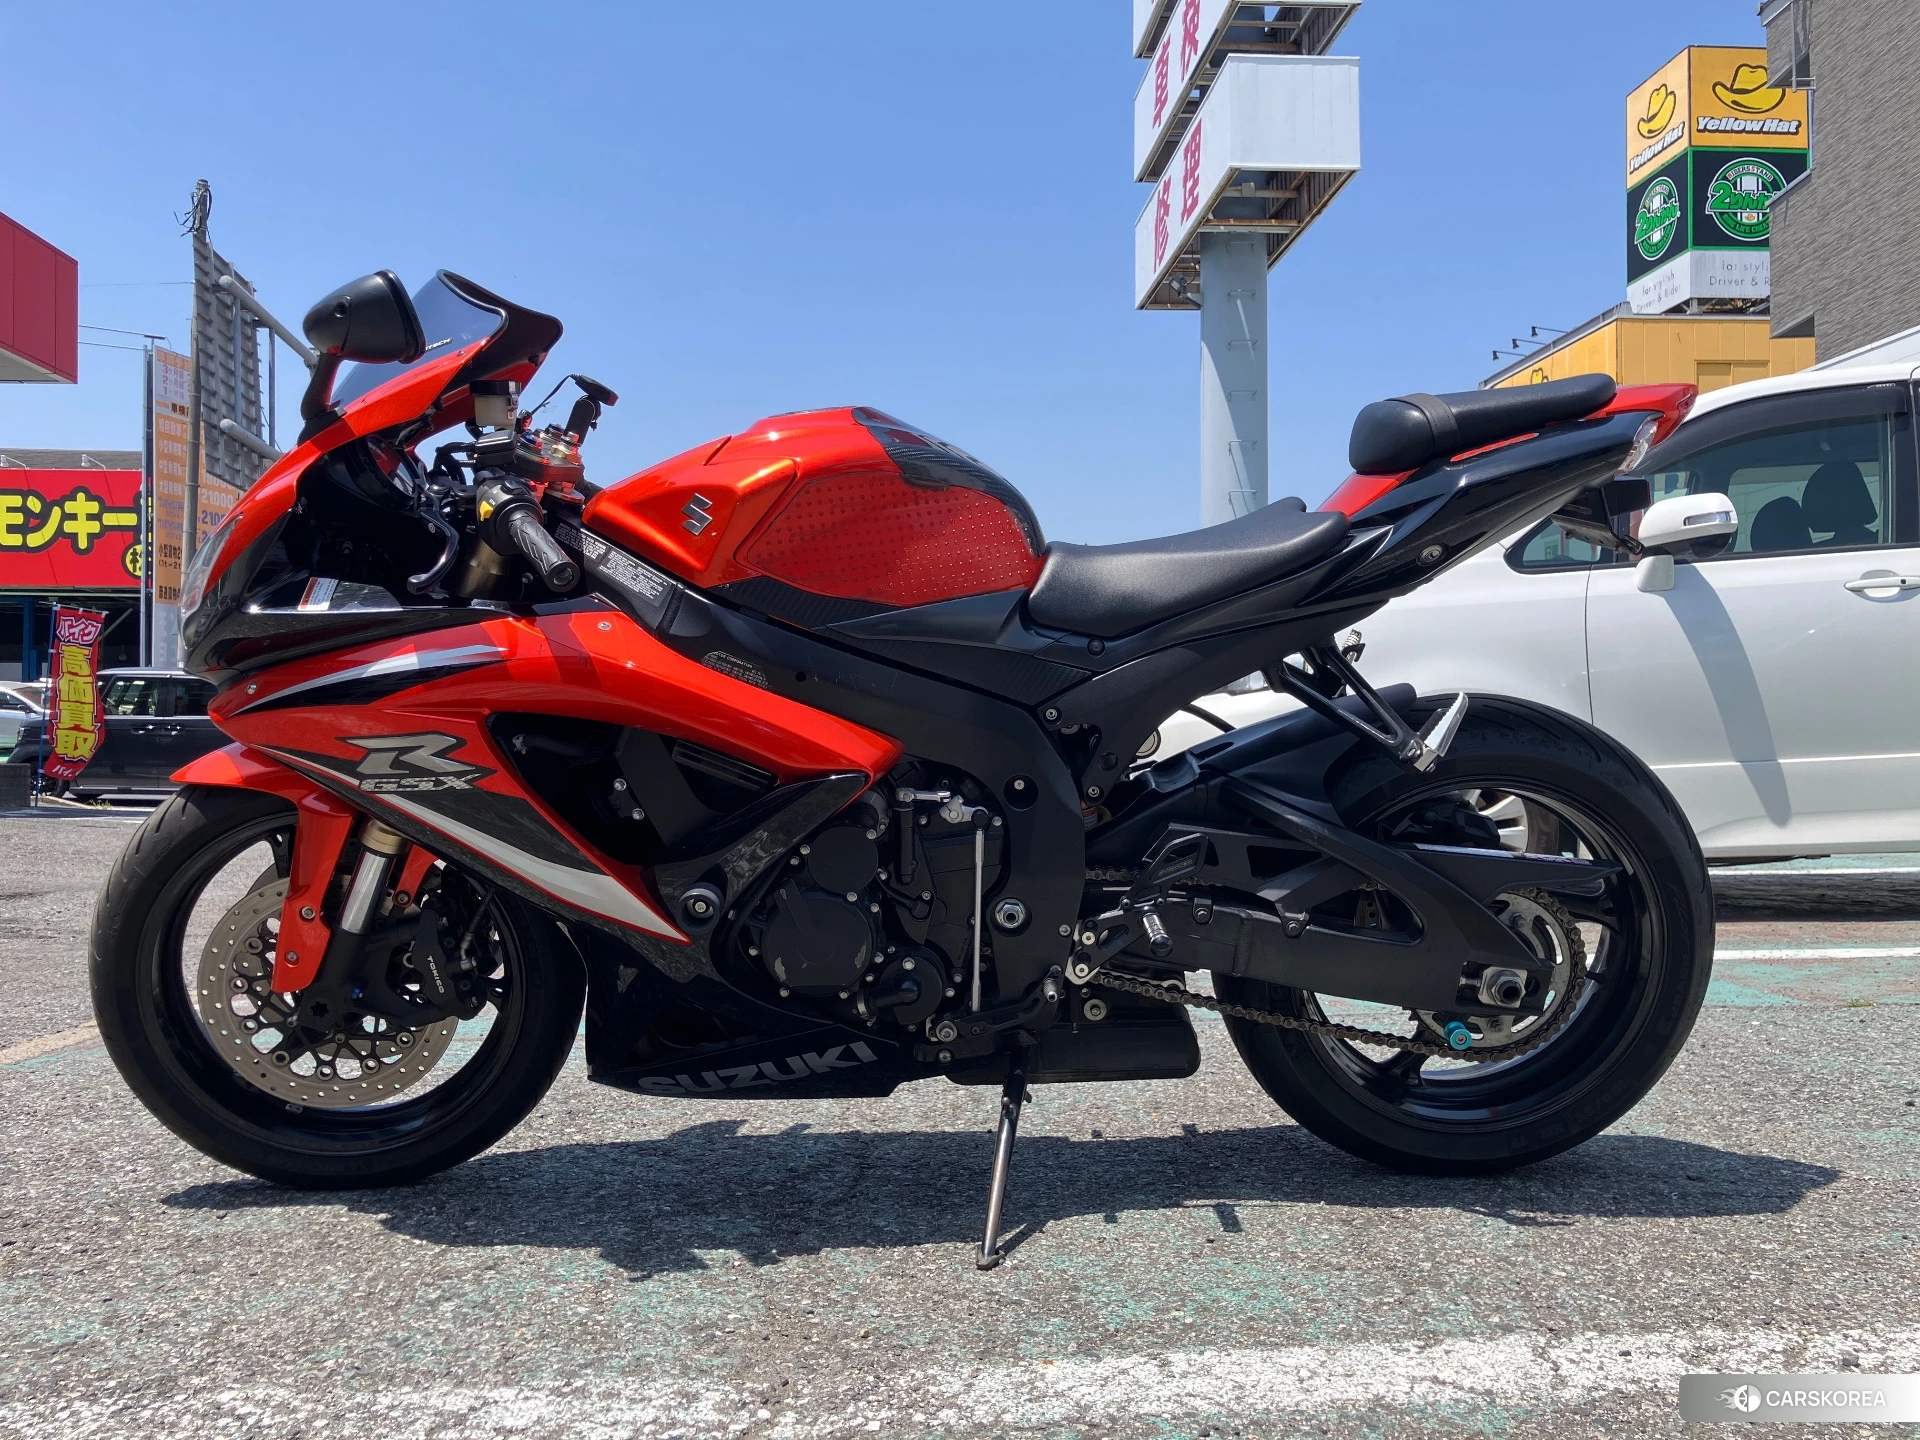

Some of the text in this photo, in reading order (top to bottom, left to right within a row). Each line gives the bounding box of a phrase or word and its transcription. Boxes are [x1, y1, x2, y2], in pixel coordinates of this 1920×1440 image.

[1153, 118, 1202, 274] 修理
[1709, 275, 1745, 286] Driver
[0, 492, 138, 550] モンキー
[57, 617, 101, 644] バイク
[54, 643, 98, 761] 高価買取
[427, 955, 445, 994] TOKICO
[638, 1041, 878, 1095] SUZUKI
